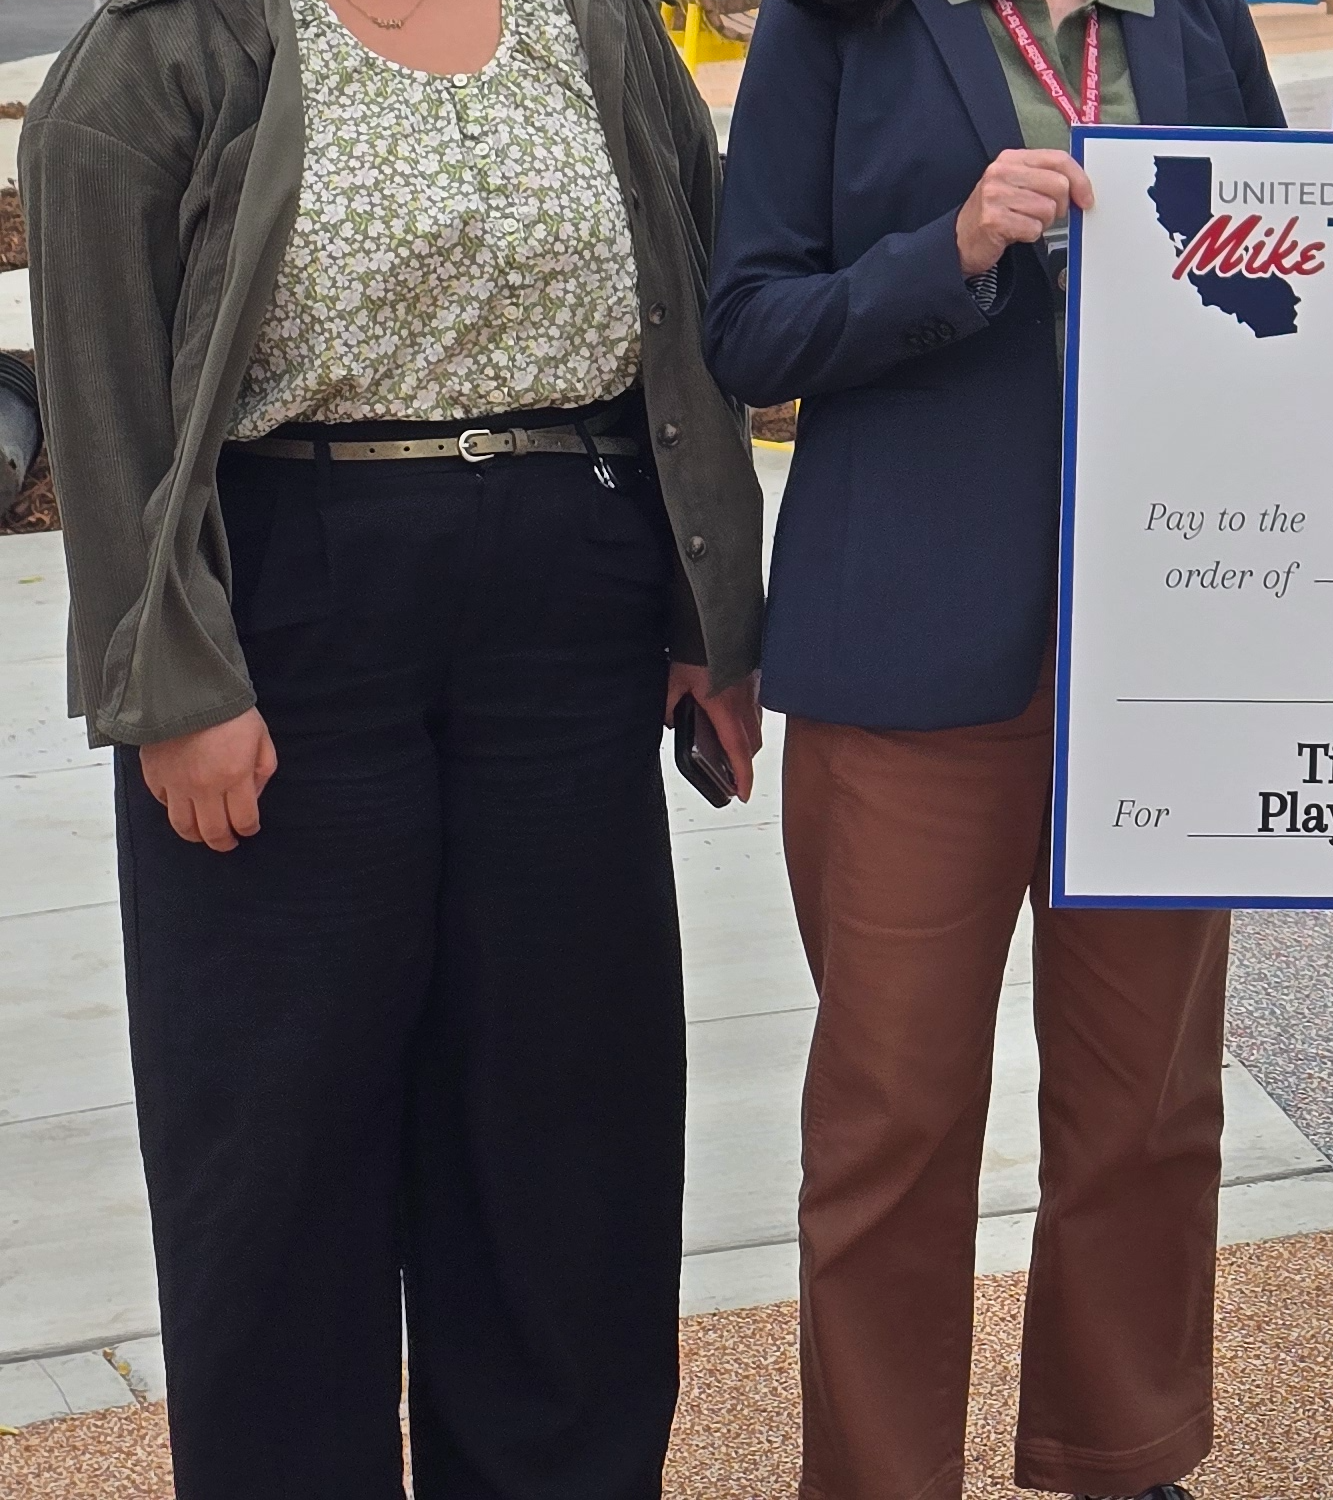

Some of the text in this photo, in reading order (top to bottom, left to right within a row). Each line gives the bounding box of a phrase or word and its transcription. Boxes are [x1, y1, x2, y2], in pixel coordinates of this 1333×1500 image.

[1171, 214, 1326, 280] Mike
[1144, 502, 1307, 541] Pay to the
[1164, 559, 1301, 599] order of
[1112, 799, 1171, 829] For
